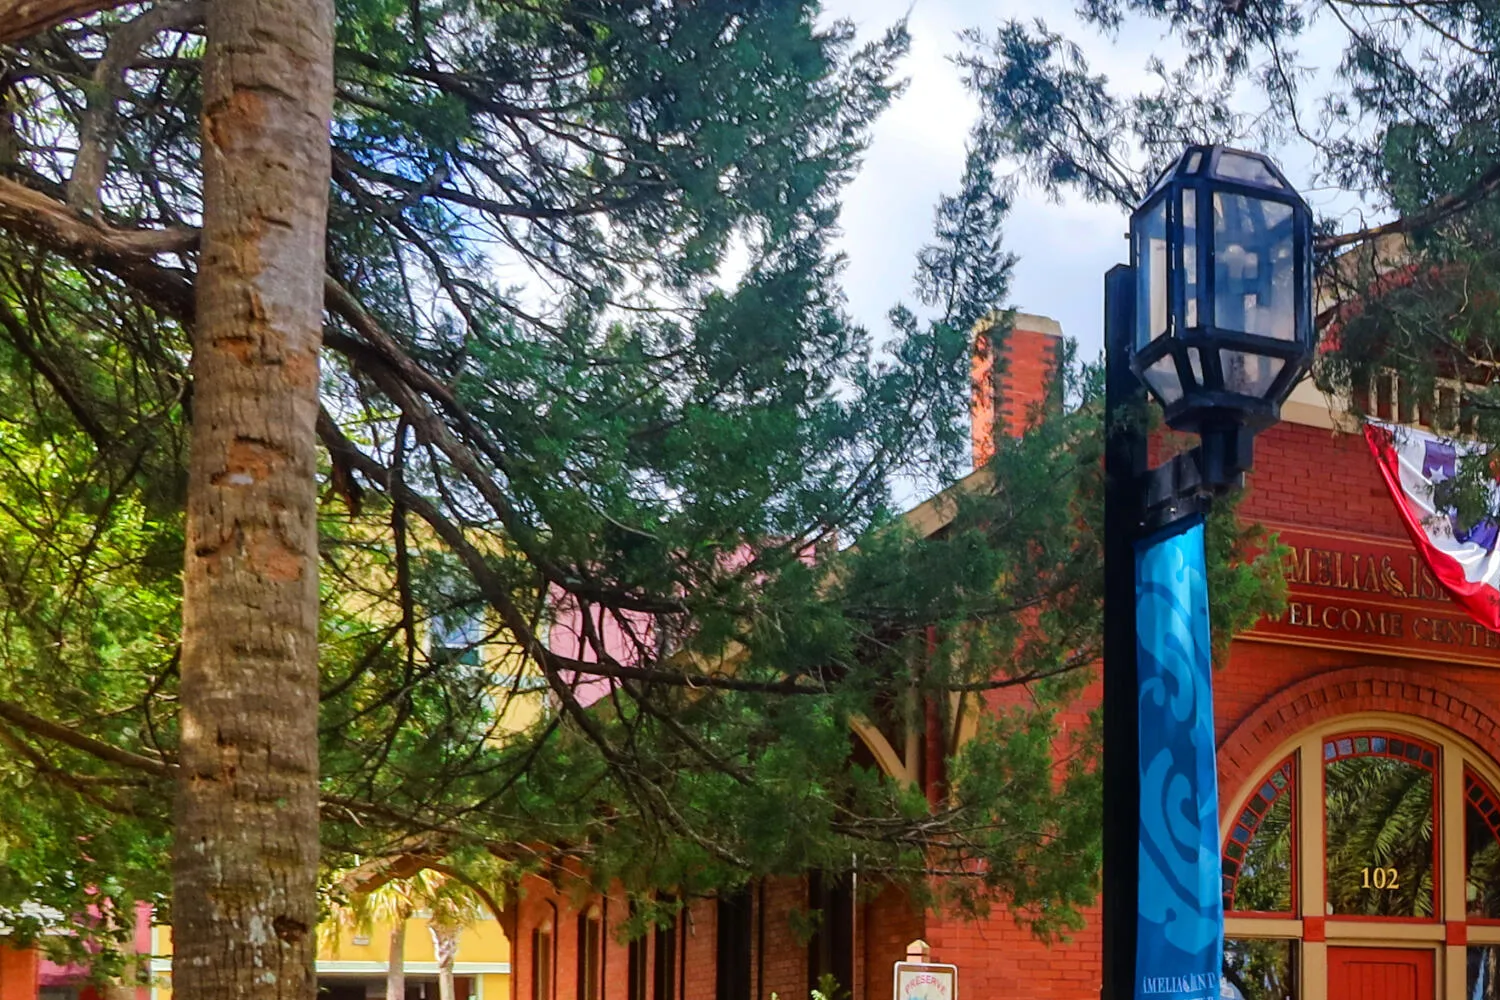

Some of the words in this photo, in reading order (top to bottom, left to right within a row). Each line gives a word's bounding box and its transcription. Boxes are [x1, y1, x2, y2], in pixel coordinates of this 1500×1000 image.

[1282, 545, 1380, 593] MELIA
[1267, 602, 1403, 636] ELCOME
[1361, 867, 1400, 889] 102
[904, 974, 945, 994] PRESERVE
